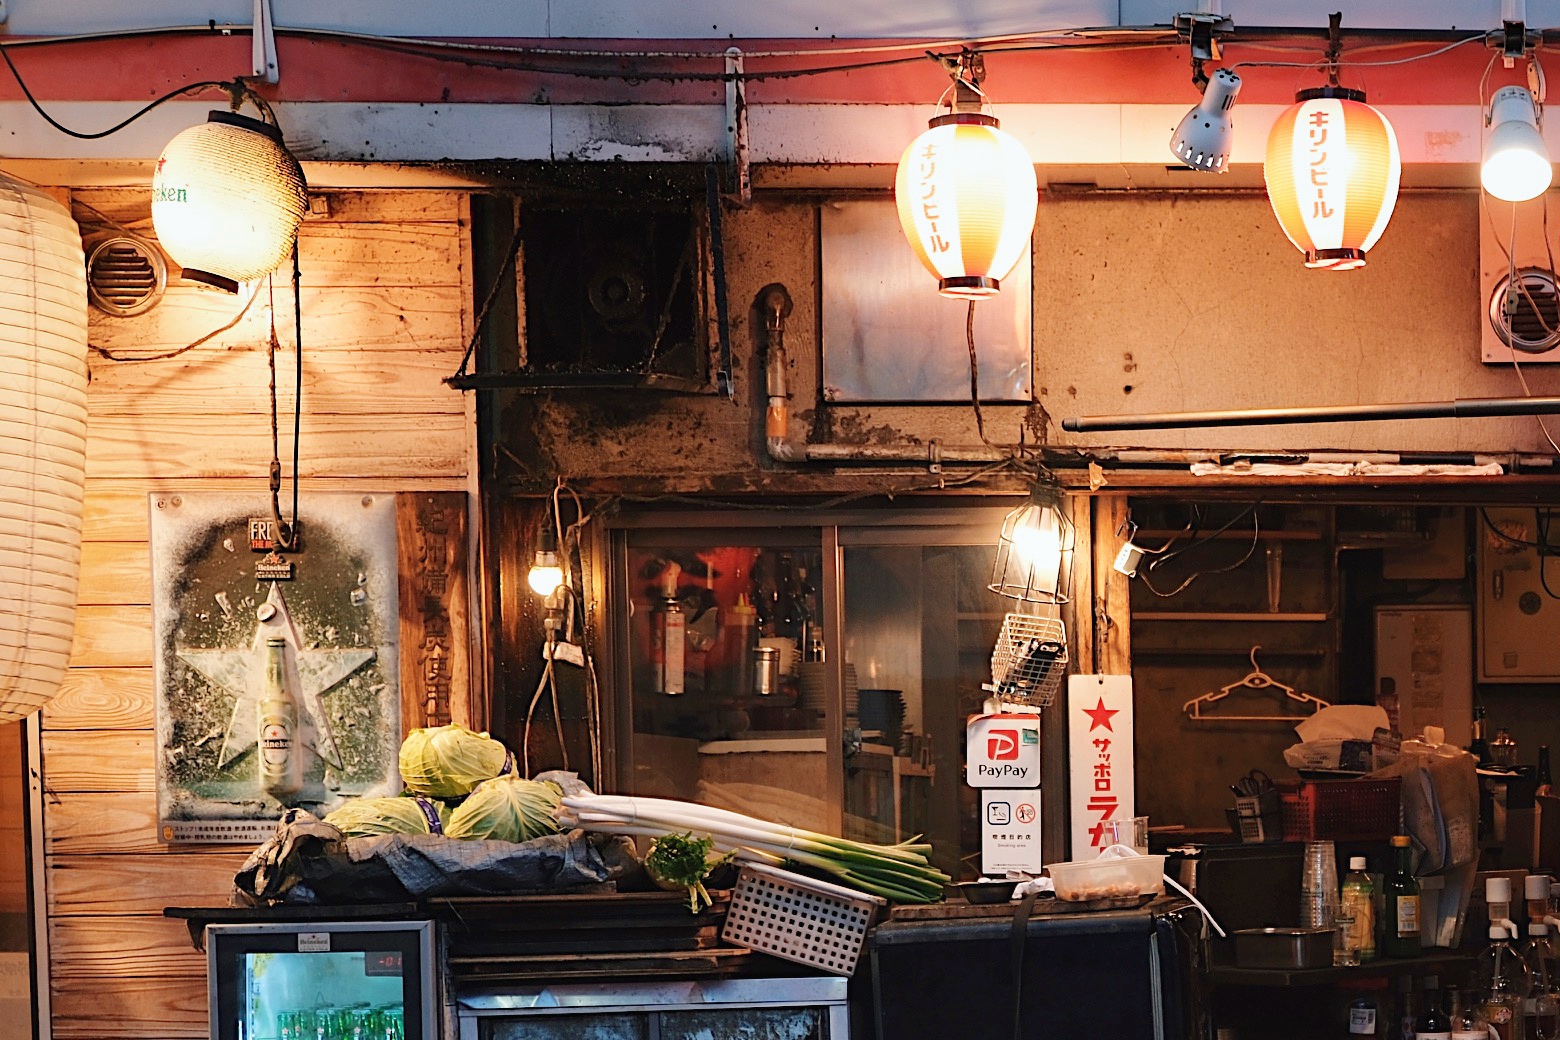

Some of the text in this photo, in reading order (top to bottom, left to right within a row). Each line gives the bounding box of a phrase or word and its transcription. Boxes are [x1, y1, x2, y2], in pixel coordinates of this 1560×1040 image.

[920, 144, 950, 254] キリンビール
[1307, 111, 1335, 219] キリンビール
[979, 764, 1028, 778] PayPay
